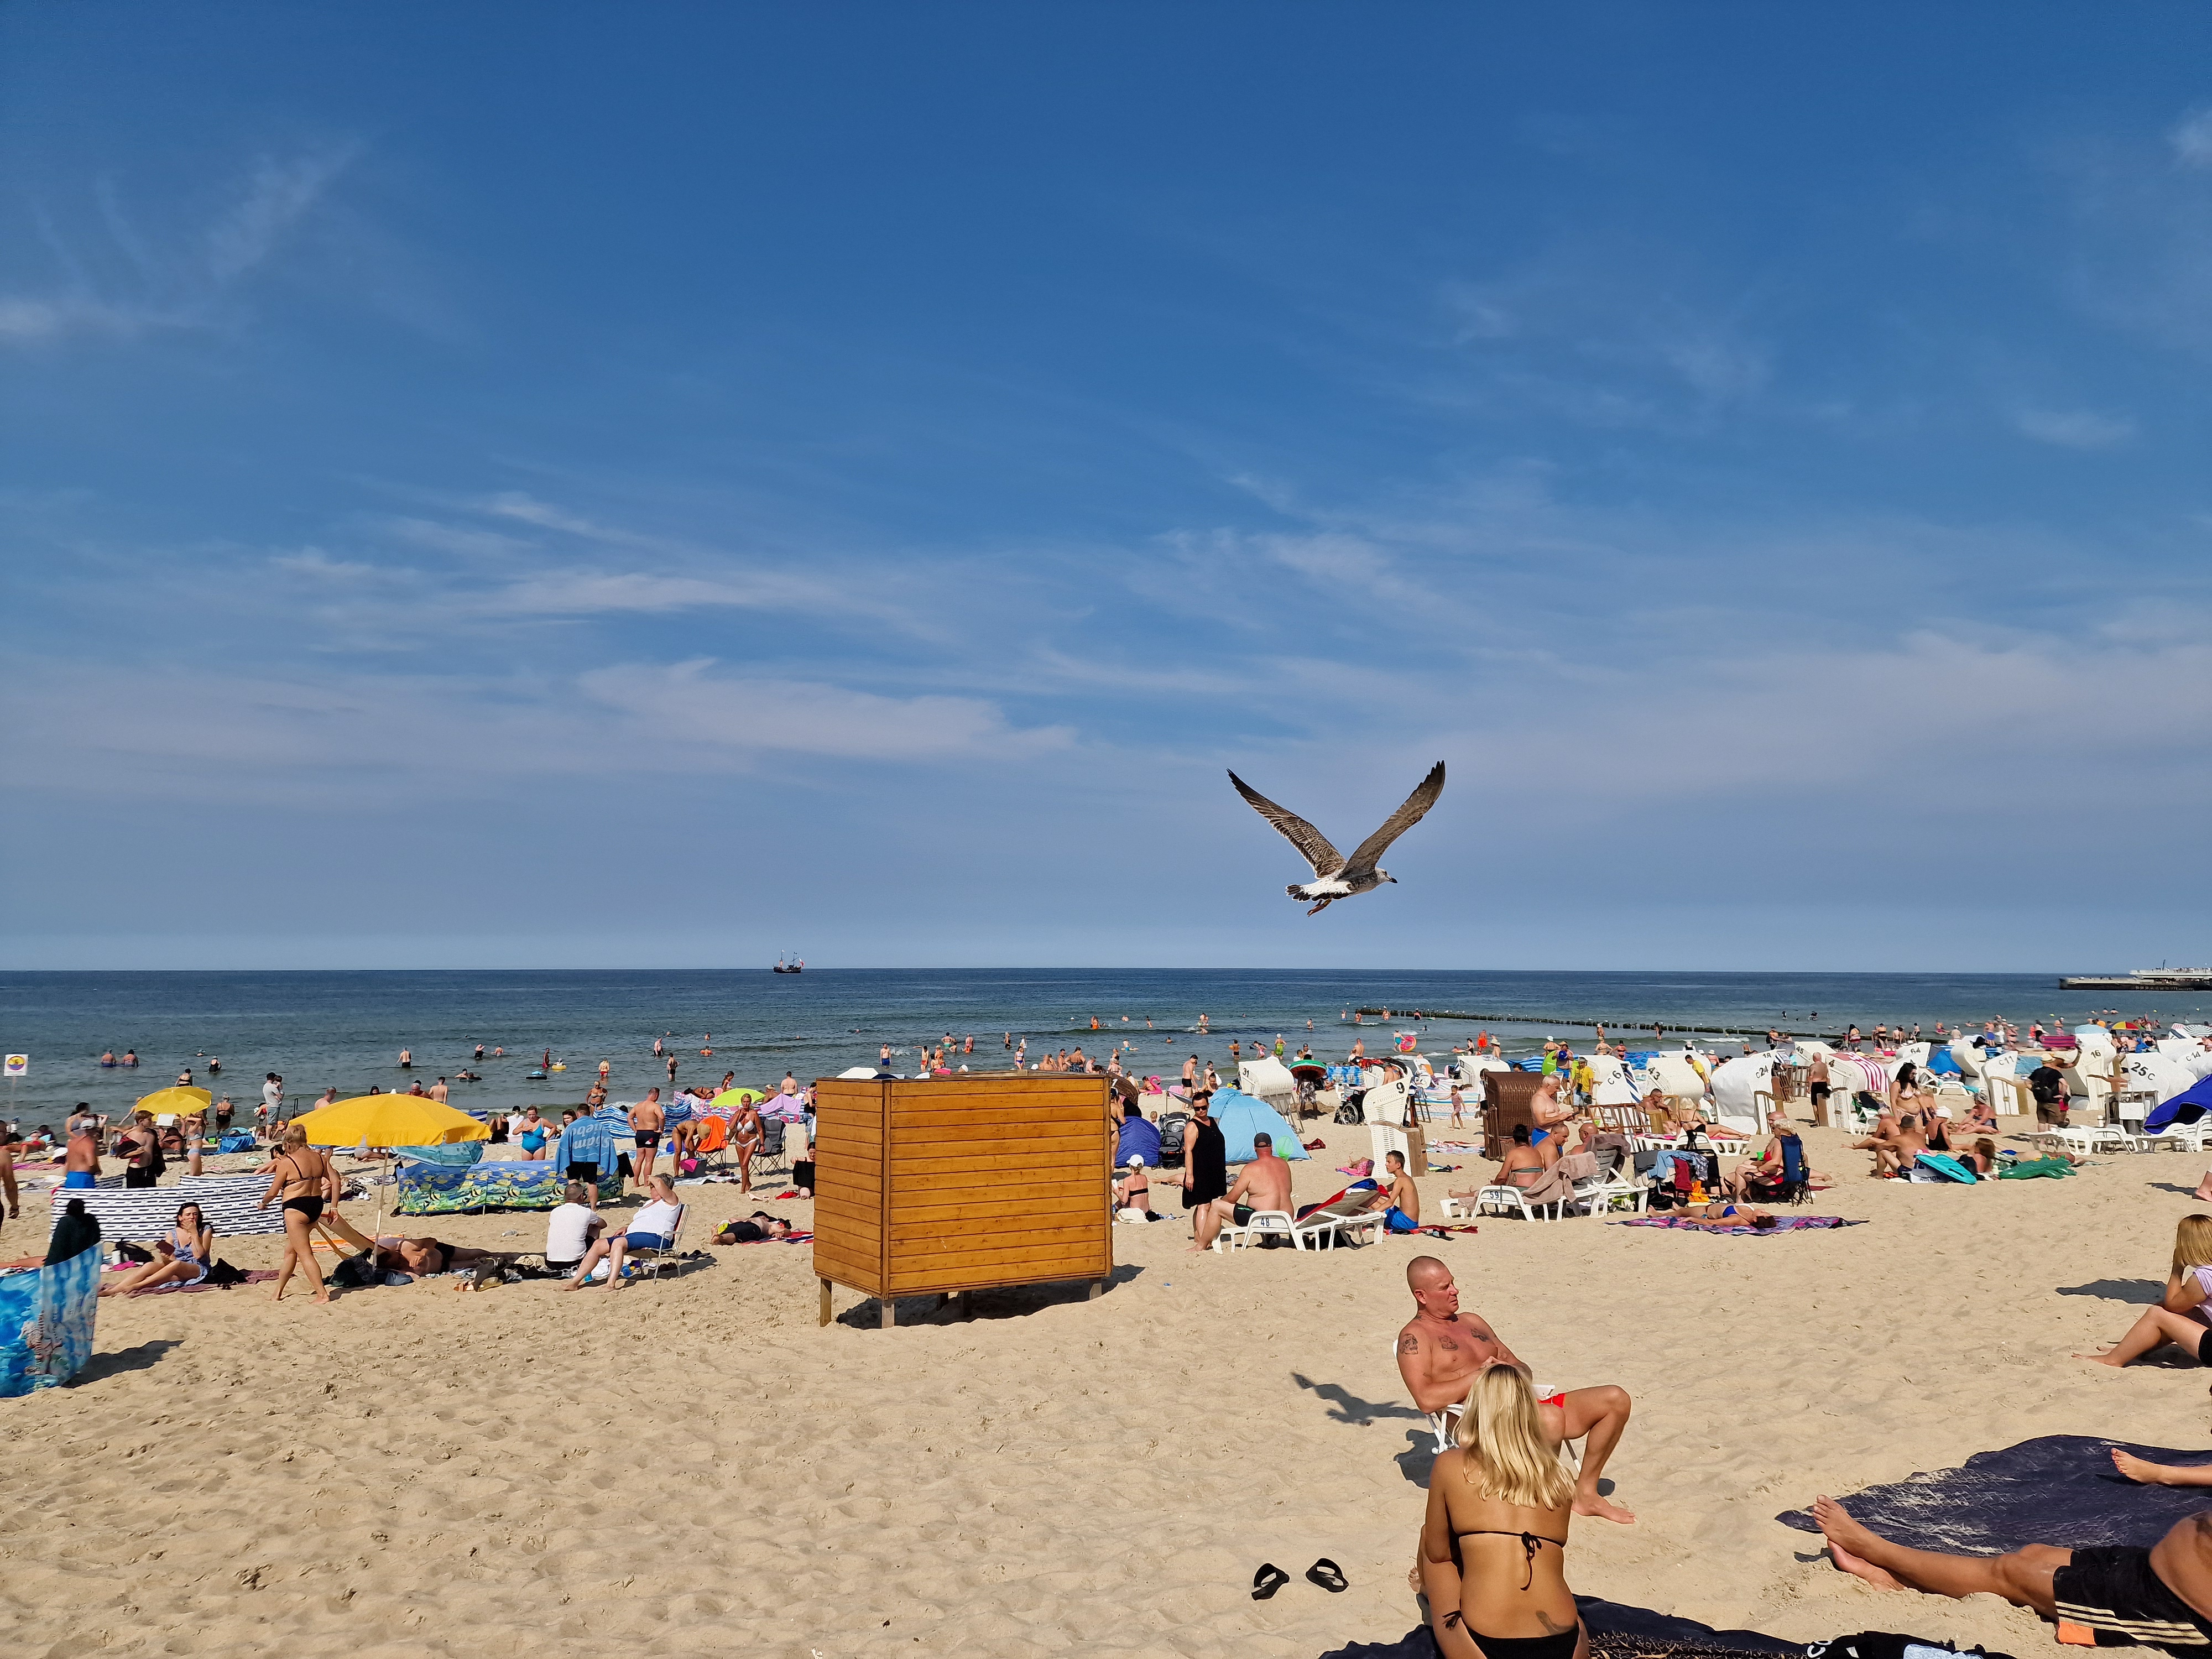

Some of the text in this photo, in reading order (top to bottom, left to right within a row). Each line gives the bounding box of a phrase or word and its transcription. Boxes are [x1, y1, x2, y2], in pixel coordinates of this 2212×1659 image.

[2090, 1050, 2101, 1058] 16
[1242, 1067, 1250, 1078] 31
[1648, 1067, 1661, 1080] 43
[1396, 1082, 1405, 1094] 9
[1489, 1191, 1499, 1199] 59
[1260, 1217, 1270, 1227] 48
